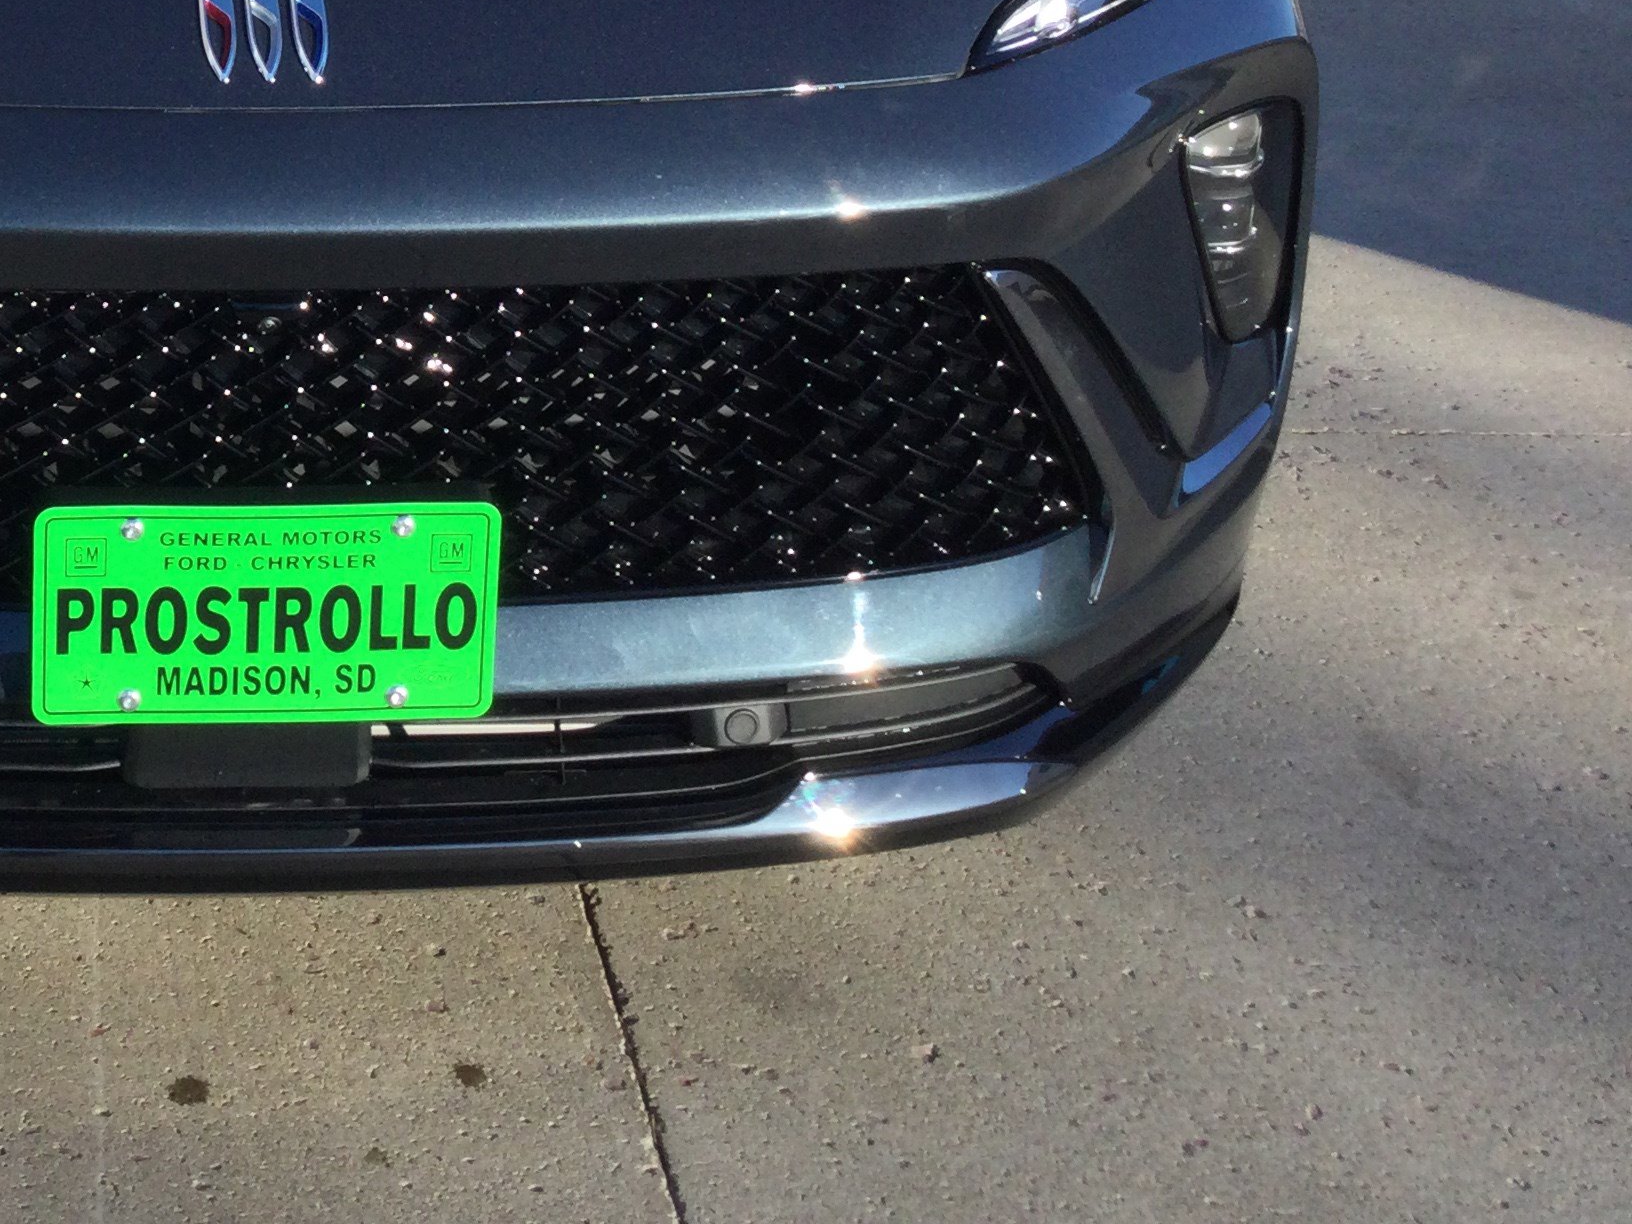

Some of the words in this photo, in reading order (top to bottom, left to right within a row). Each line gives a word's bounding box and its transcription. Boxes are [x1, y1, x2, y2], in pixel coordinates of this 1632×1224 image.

[159, 531, 272, 547] GENERAL
[282, 530, 382, 545] MOTORS
[73, 546, 99, 564] GM
[438, 541, 465, 559] GM
[164, 556, 228, 571] FORD
[251, 554, 377, 571] CHRYSLER
[55, 582, 478, 656] PROSTROLLO
[156, 666, 323, 699] MADISON,
[334, 664, 377, 694] SD
